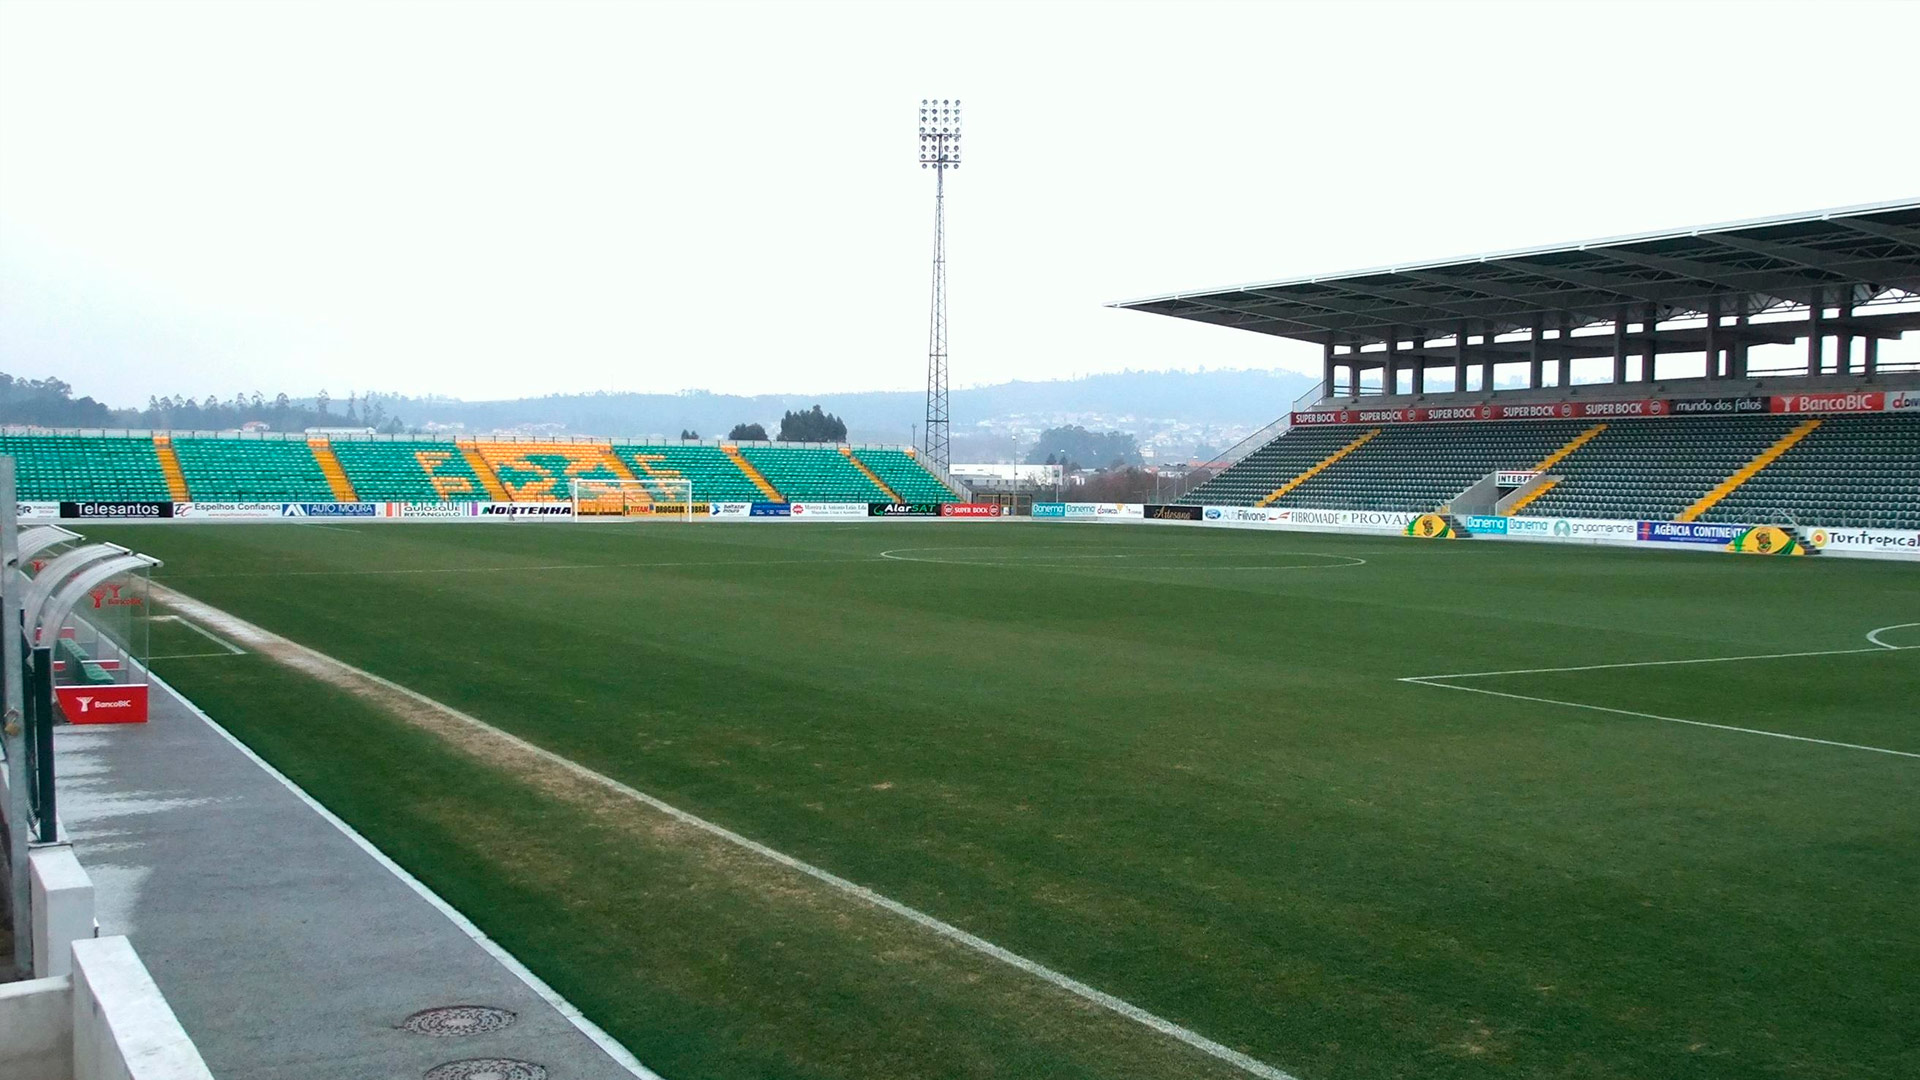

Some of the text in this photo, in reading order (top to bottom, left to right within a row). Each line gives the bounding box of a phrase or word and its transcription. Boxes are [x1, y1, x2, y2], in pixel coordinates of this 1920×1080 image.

[1585, 402, 1643, 415] SUPER BOCK
[1676, 400, 1711, 412] mundo
[1714, 399, 1732, 410] dos
[1799, 394, 1872, 412] BancoBIC
[1359, 410, 1403, 421] SUPER BOCK
[1428, 408, 1476, 419] SUPER BOCK
[1502, 405, 1555, 417] SUPER BOCK
[1295, 413, 1336, 423] SUPER BOCK
[75, 502, 159, 515] Telesantos
[194, 503, 281, 511] Espelhos Confiança
[311, 504, 373, 513] AUTO MOURA
[482, 504, 572, 515] NORTENHA
[884, 504, 936, 513] AlarSAT
[955, 506, 988, 514] SUPER BOCK
[1033, 503, 1064, 513] Banema
[1066, 504, 1096, 513] Banema
[1291, 512, 1340, 525] FIBROMADE
[1467, 516, 1504, 529] Banema
[1509, 518, 1548, 531] Banema
[1654, 523, 1690, 536] AGÊNCIA
[1829, 530, 1920, 547] Turitropical
[94, 700, 132, 709] BancoBIC
